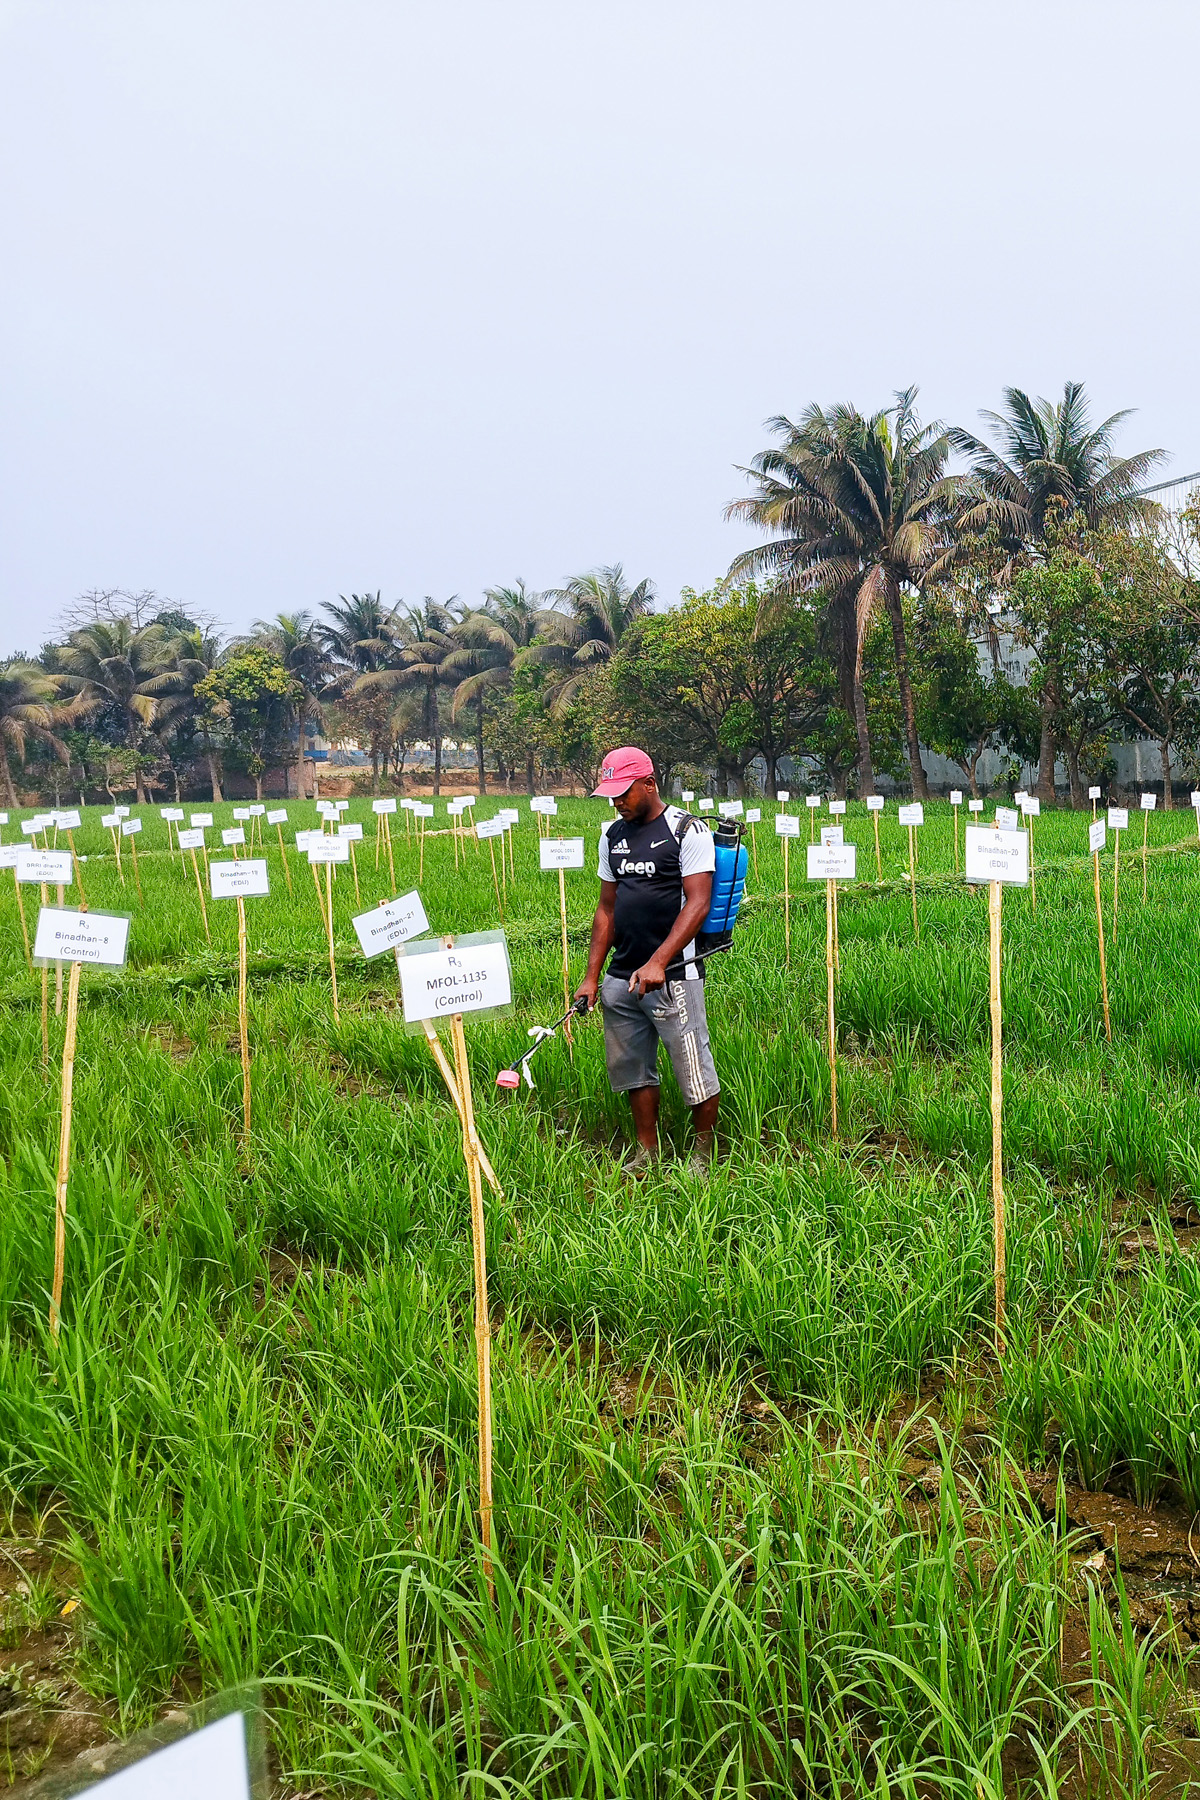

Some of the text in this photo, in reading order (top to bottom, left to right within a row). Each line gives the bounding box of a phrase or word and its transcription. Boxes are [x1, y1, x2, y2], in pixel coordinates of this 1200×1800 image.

[617, 858, 656, 877] Jeep
[370, 911, 415, 936] Binadhan-21
[55, 932, 109, 944] Binadhan-8
[387, 928, 408, 942] (EDU)
[60, 946, 100, 958] (Control)
[426, 970, 487, 990] MFOL-1135
[434, 990, 483, 1009] (Control)
